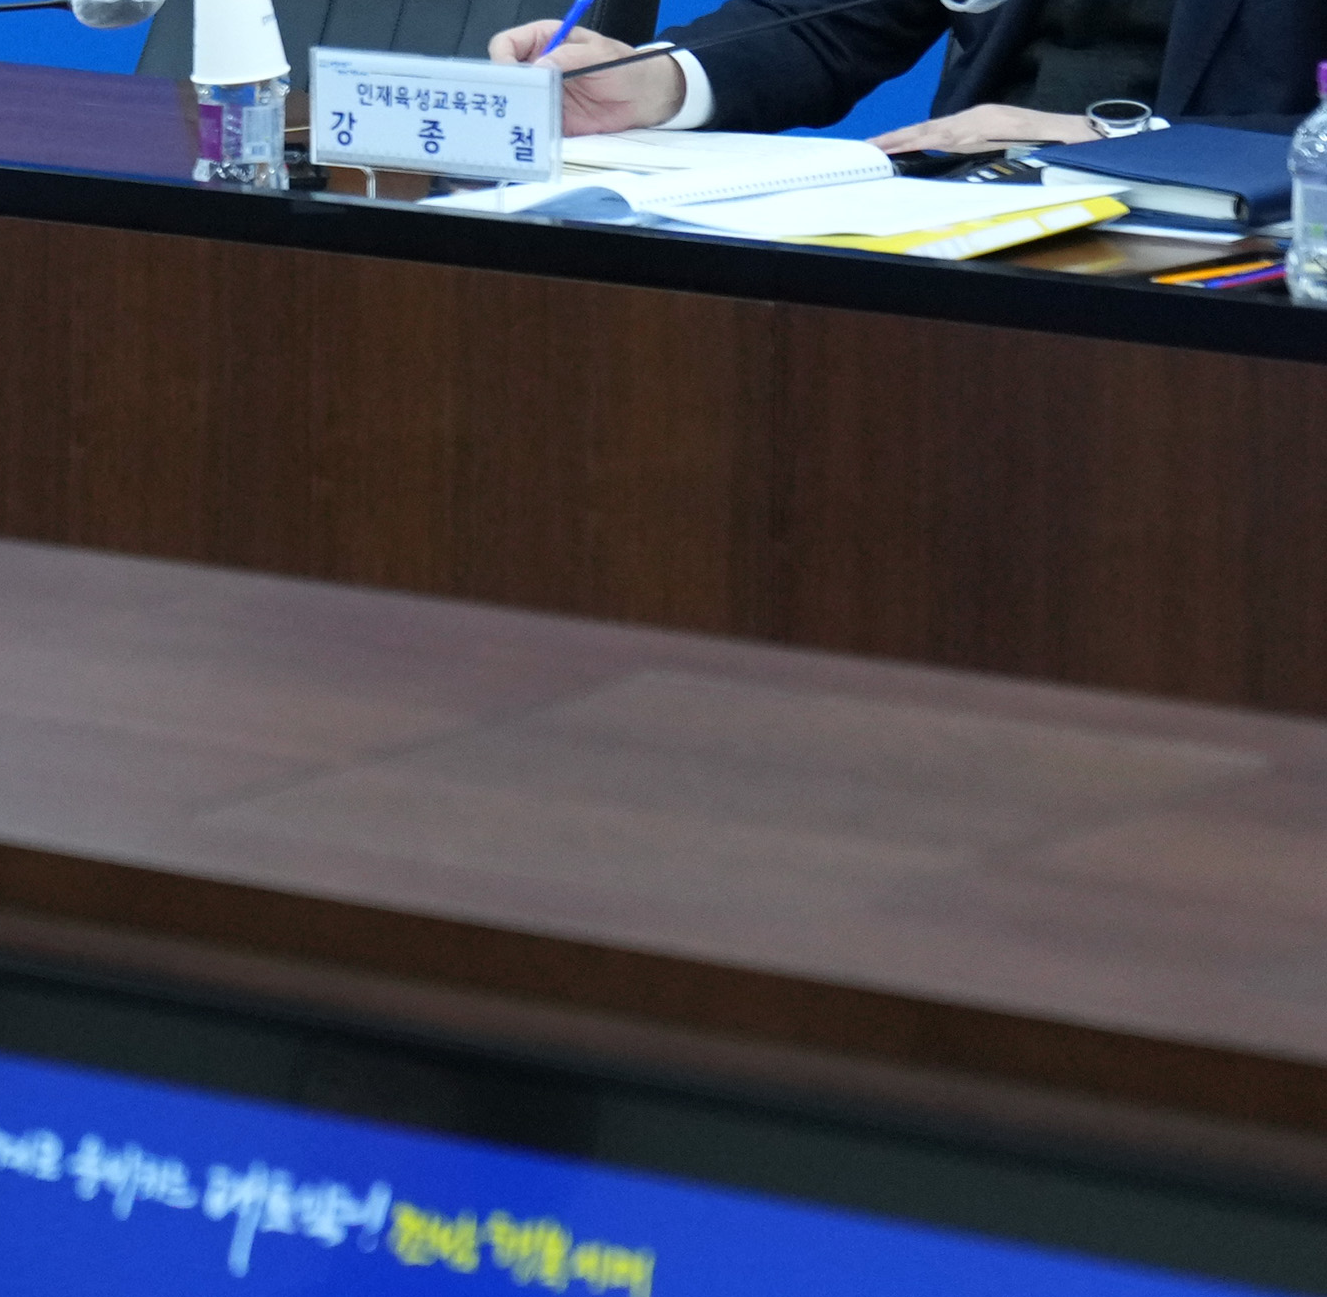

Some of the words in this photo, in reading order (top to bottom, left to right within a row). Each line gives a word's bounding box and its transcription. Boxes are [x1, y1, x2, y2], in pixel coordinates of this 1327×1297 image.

[356, 82, 508, 118] 인재육성교육국장
[330, 111, 356, 146] 강
[418, 119, 446, 154] 종
[510, 126, 535, 163] 철
